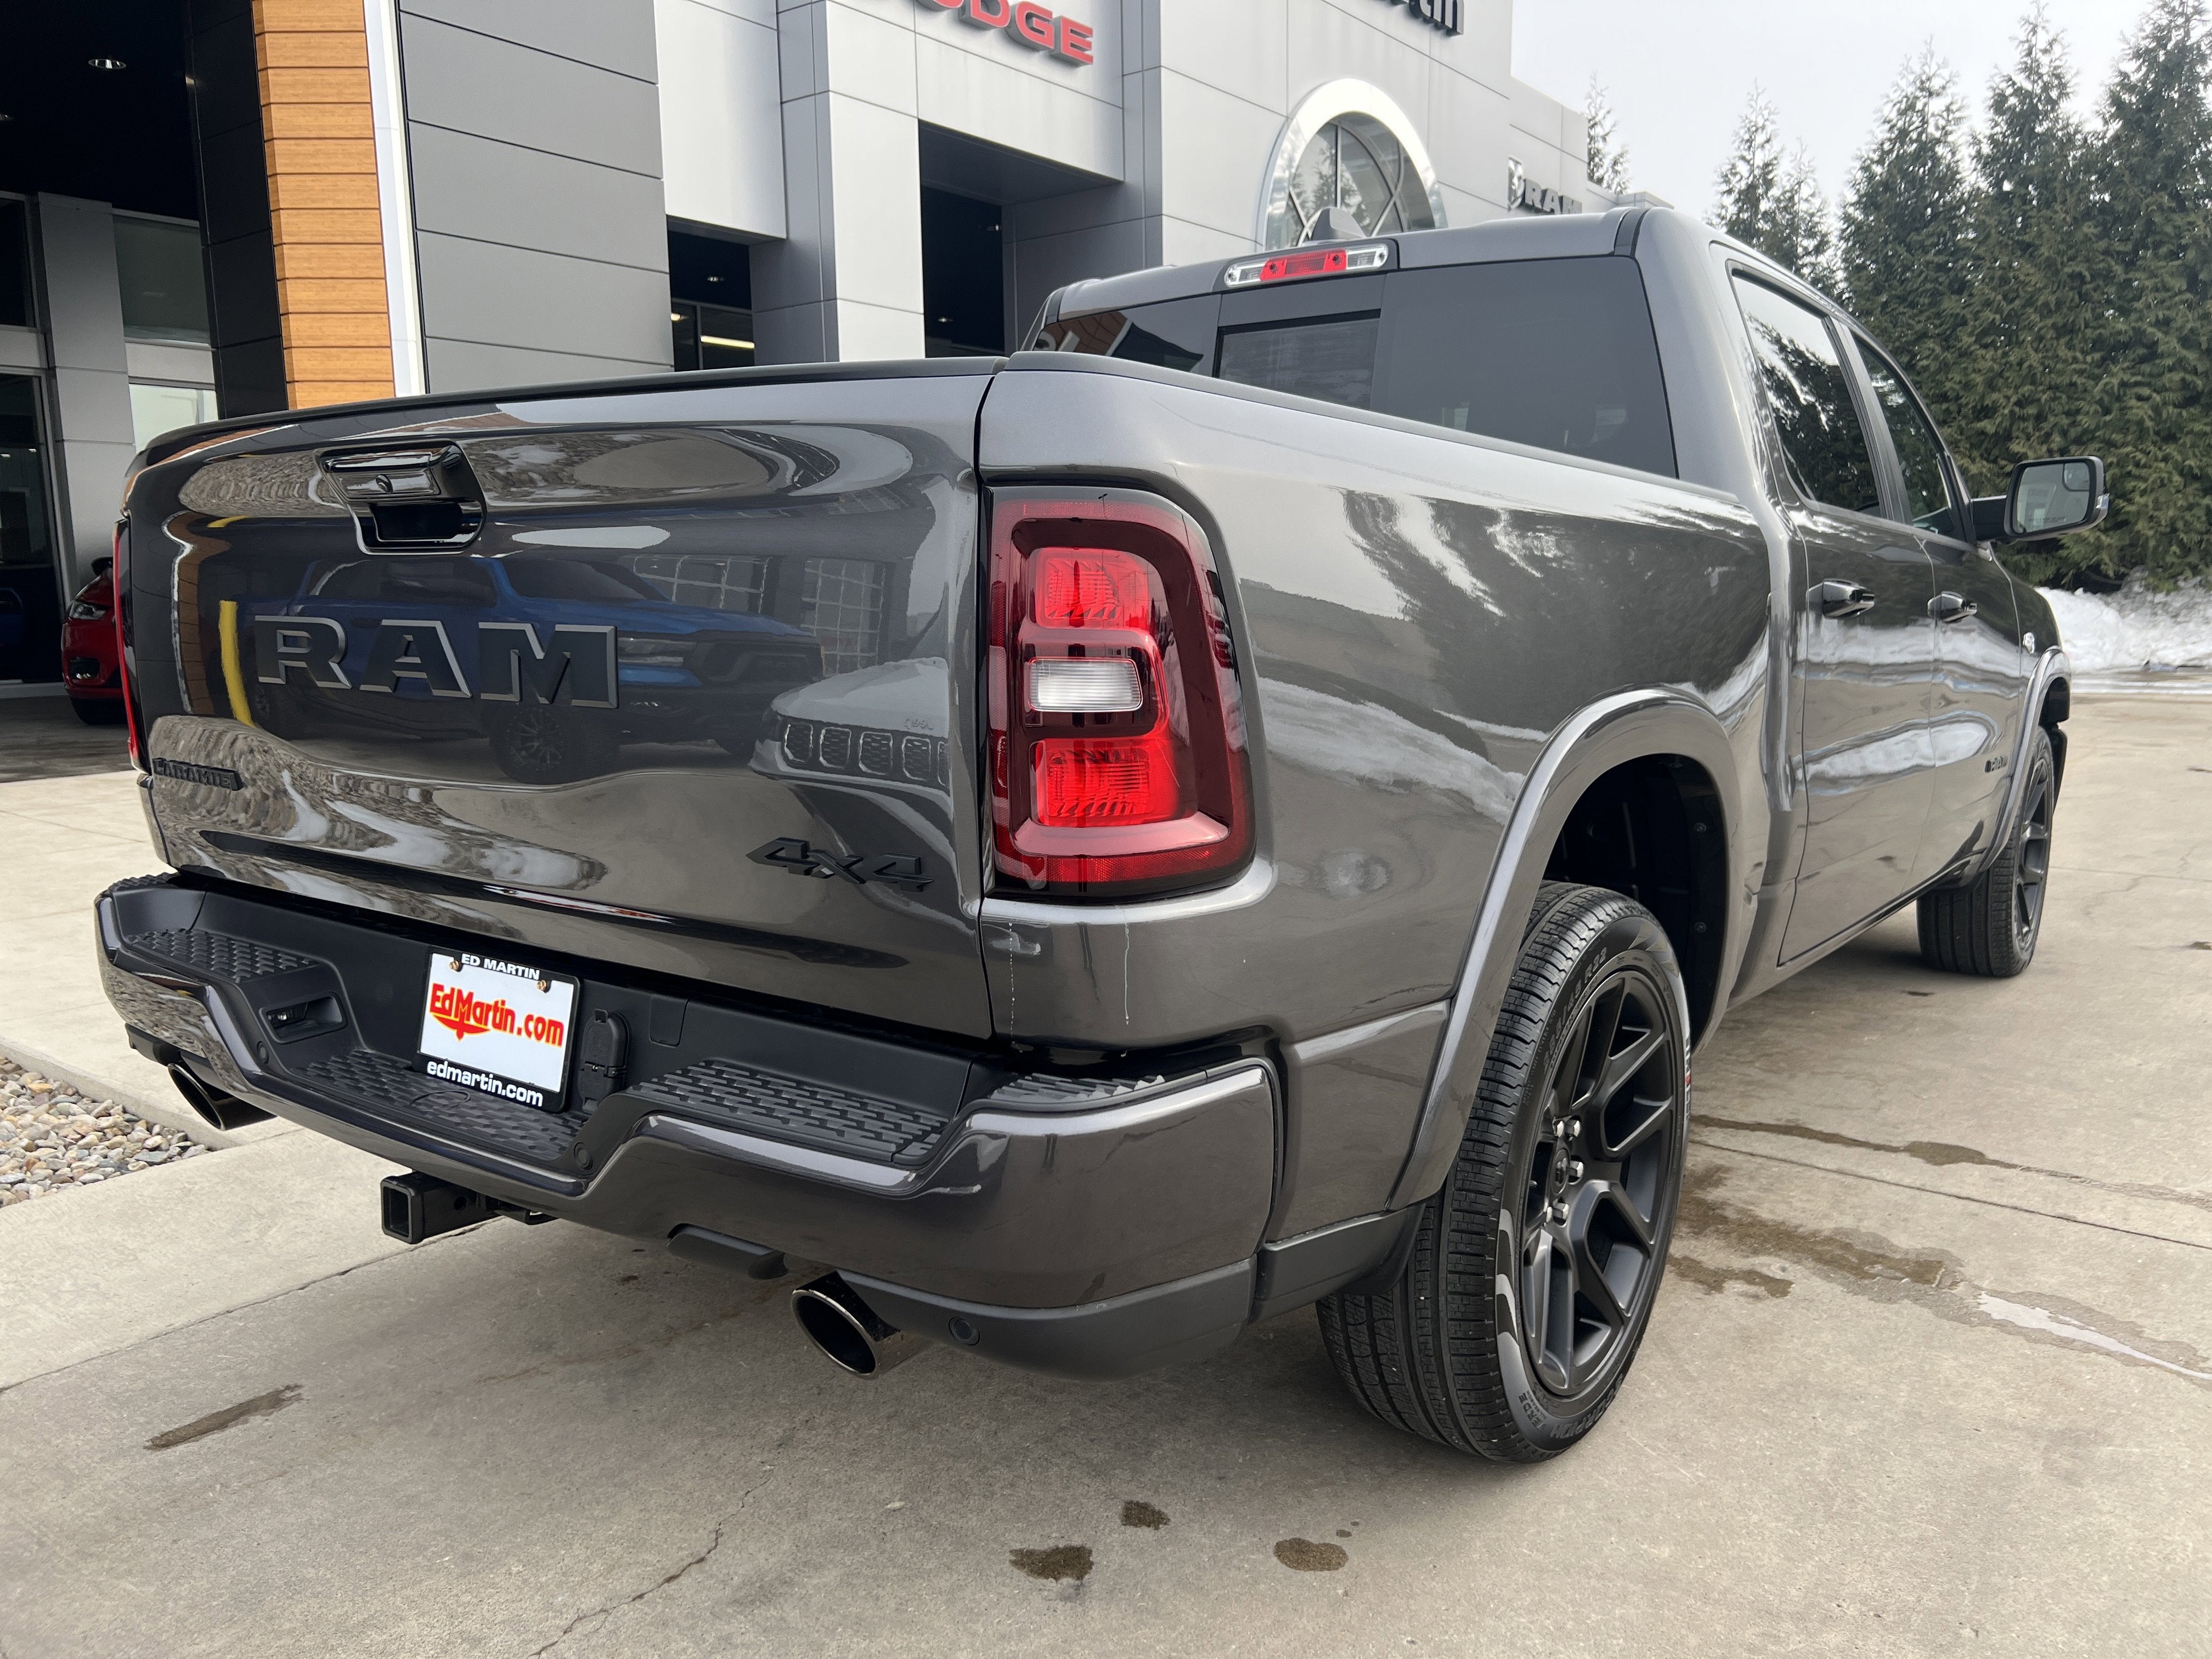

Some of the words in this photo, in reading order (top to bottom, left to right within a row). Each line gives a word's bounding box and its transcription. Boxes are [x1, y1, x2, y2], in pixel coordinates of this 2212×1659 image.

[934, 0, 1093, 65] DGE
[1523, 178, 1582, 215] RAM
[255, 615, 619, 709] RAM
[461, 953, 481, 966] ED
[483, 958, 540, 980] MARTIN
[426, 1060, 543, 1107] edmartin.com
